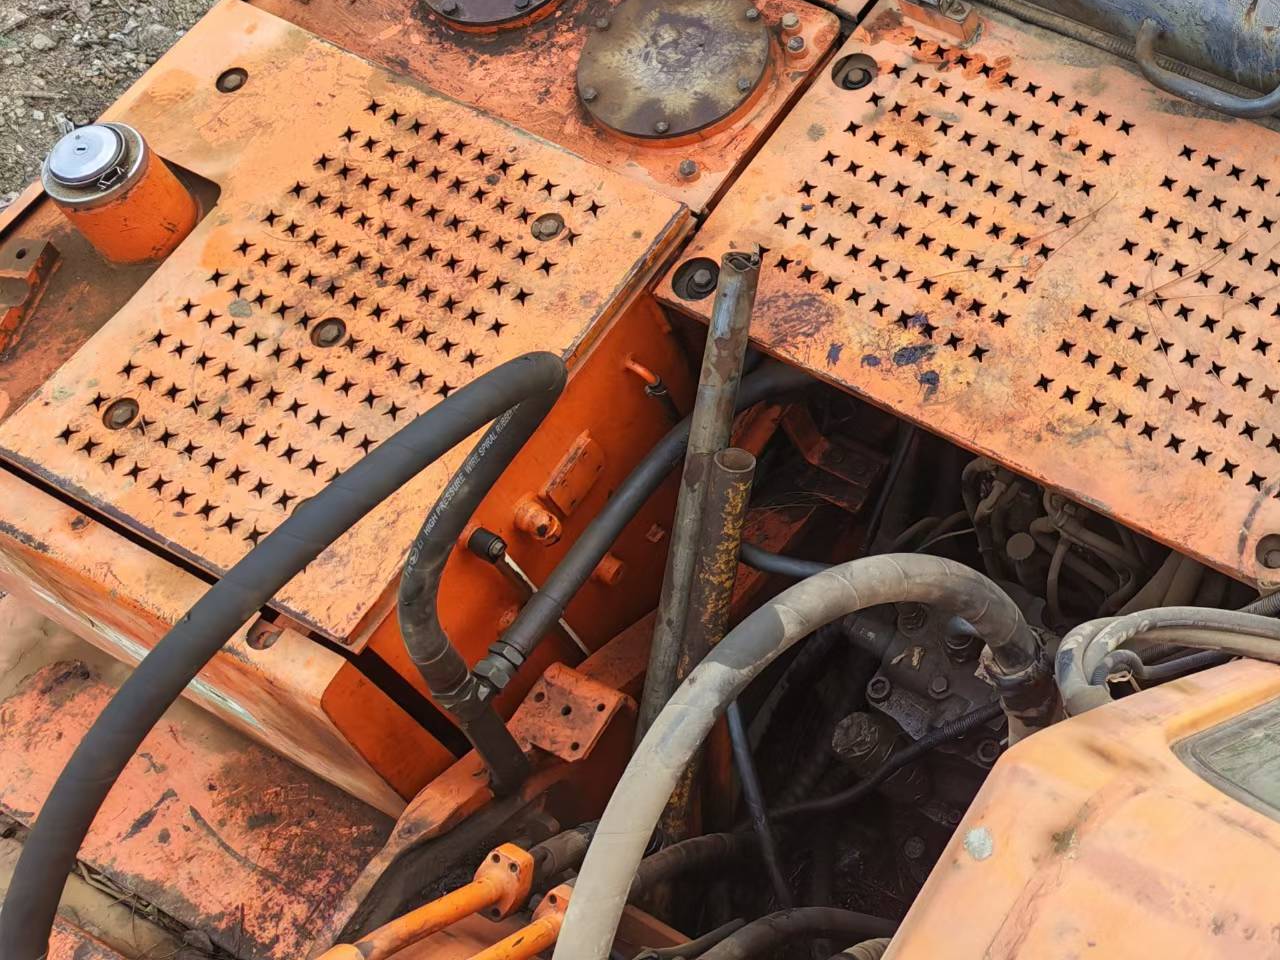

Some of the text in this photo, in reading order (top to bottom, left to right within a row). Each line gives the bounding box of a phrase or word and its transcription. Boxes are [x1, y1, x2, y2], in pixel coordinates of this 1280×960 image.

[423, 513, 438, 536] HIGH
[435, 472, 466, 515] PRESSURE
[464, 452, 481, 474] WIRE
[478, 431, 498, 457] SPIRAL
